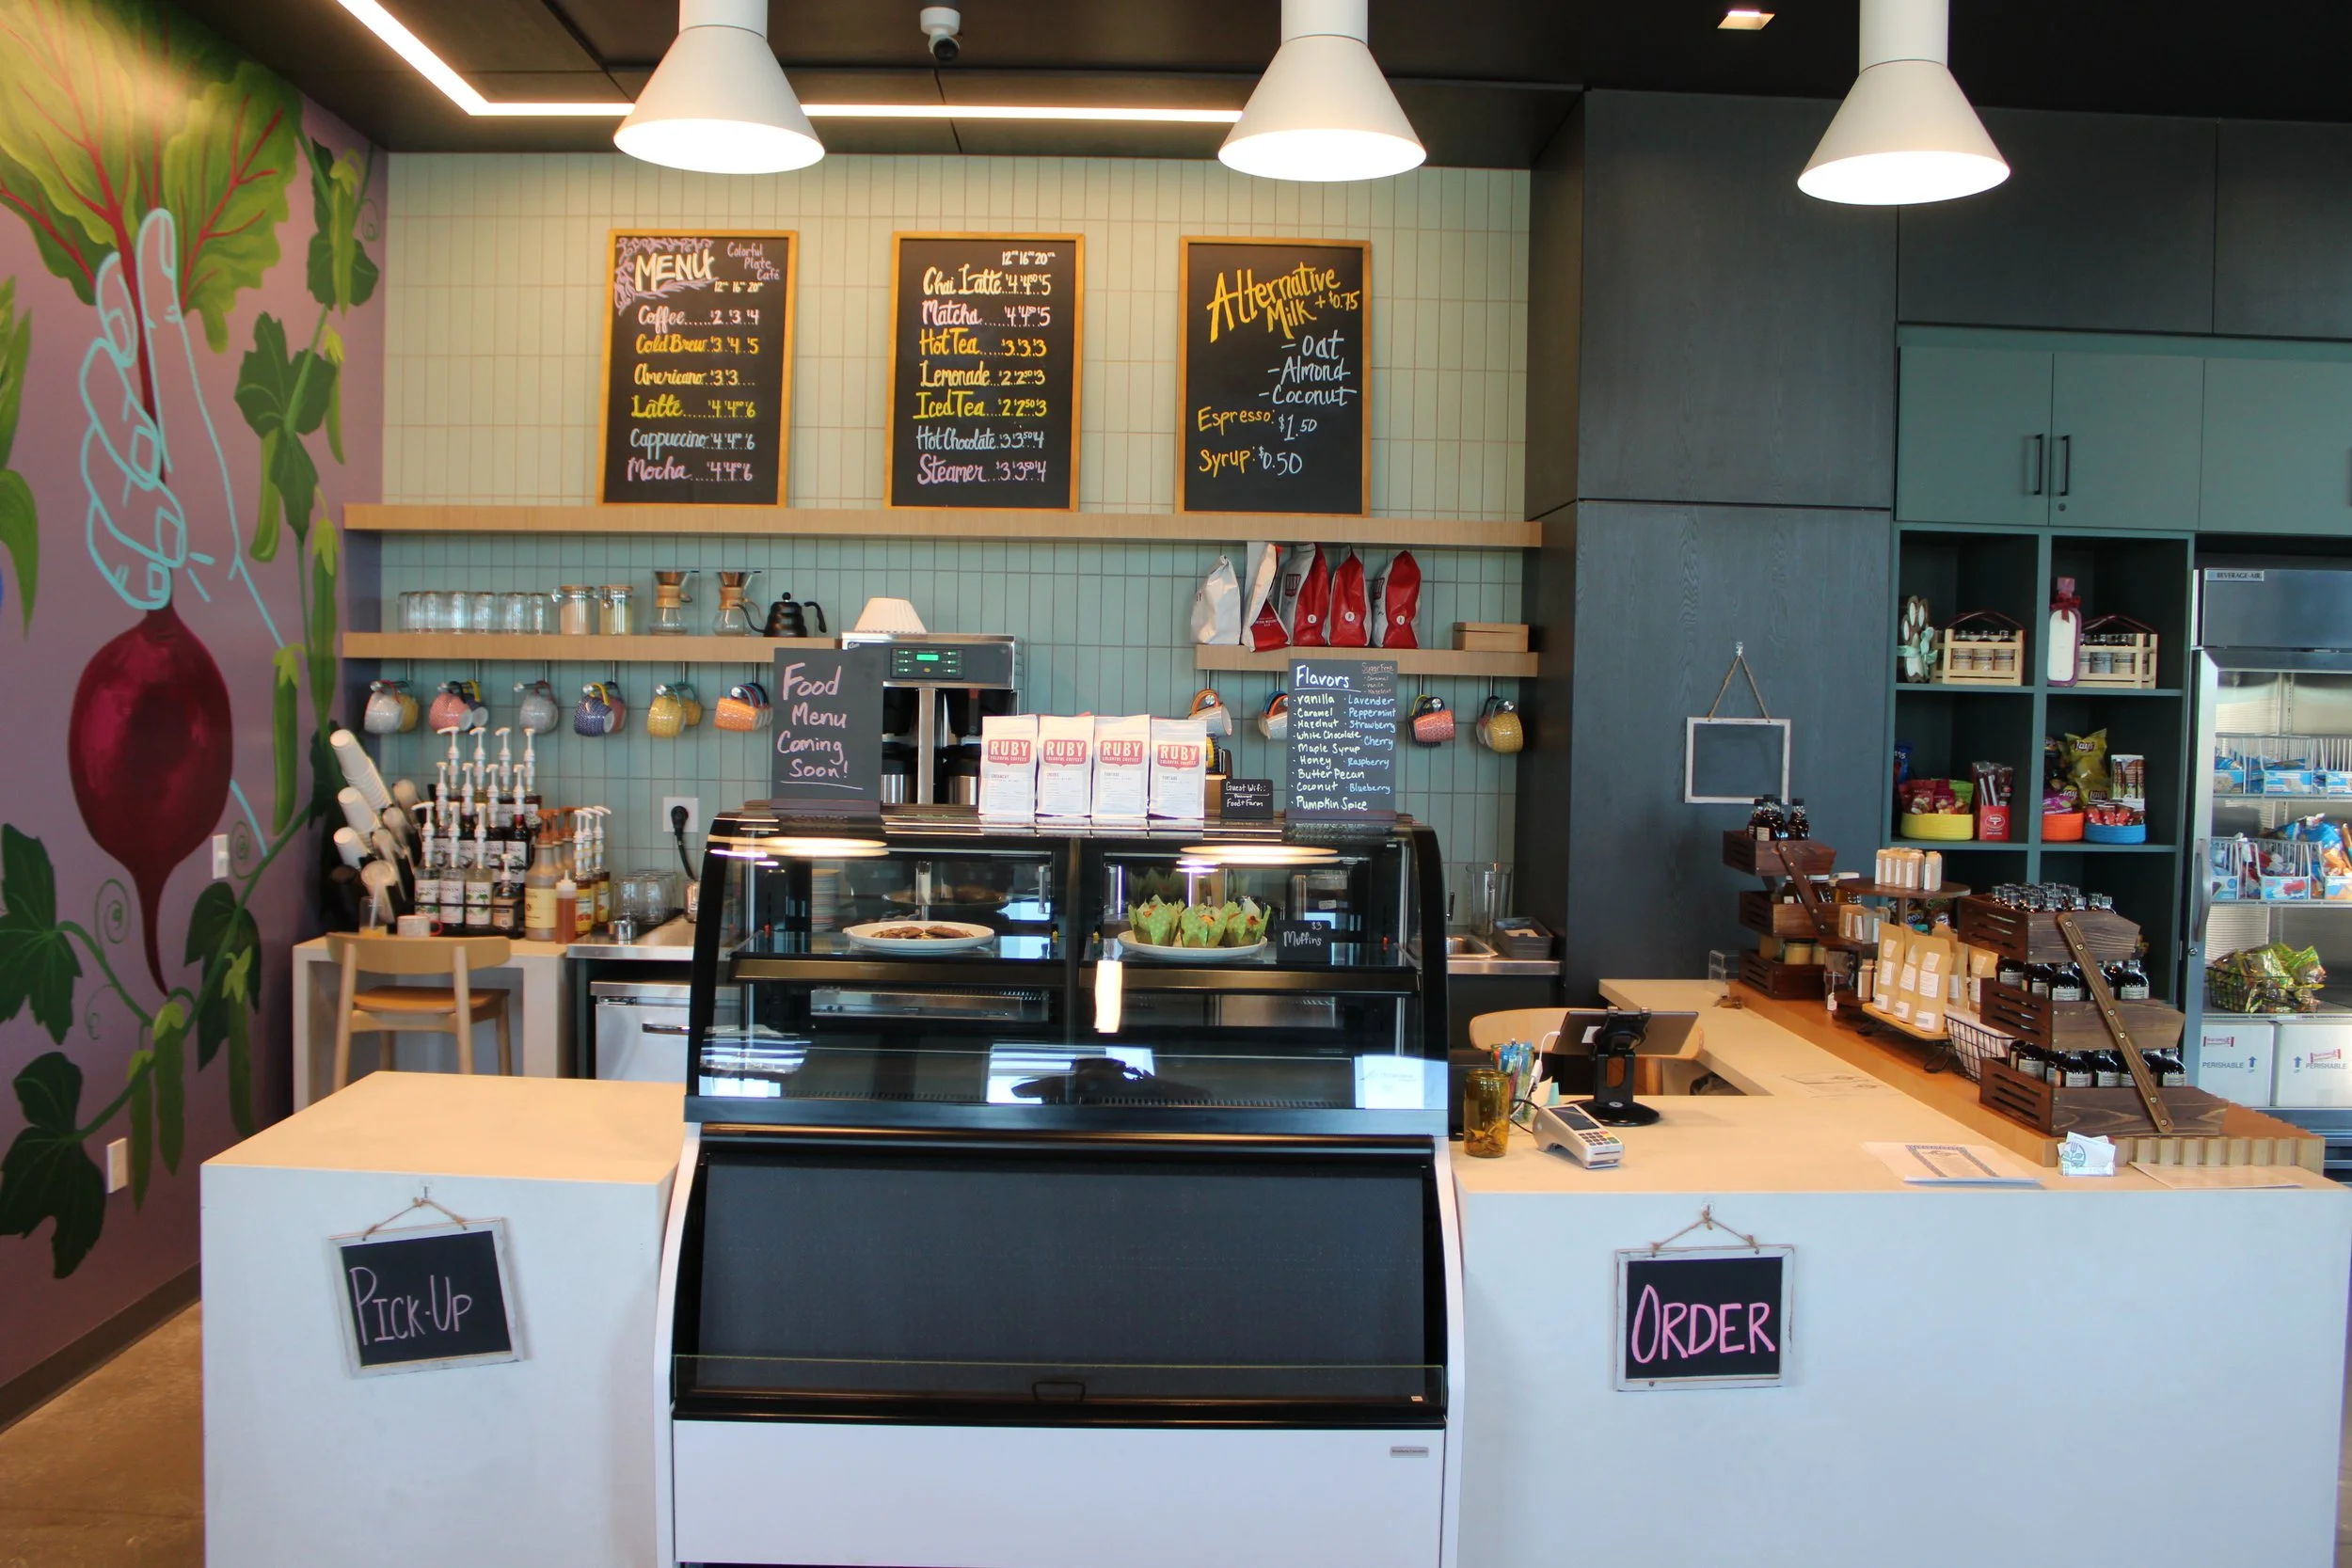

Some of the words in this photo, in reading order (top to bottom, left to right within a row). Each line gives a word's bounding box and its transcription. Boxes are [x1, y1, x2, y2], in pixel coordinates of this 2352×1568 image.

[727, 242, 763, 258] Colorful
[634, 248, 715, 292] MENU
[743, 257, 771, 270] Plate
[923, 266, 957, 295] Chai
[958, 263, 1003, 295] Latte
[922, 299, 983, 326] Matcha
[1206, 261, 1341, 343] Alternative
[638, 305, 686, 334] Coffee
[1266, 298, 1317, 340] Milk
[1328, 291, 1360, 311] $0.75
[636, 333, 669, 355] Cold
[669, 334, 707, 354] Brew
[919, 327, 951, 356] Hot
[949, 327, 980, 356] Tea
[634, 363, 706, 386] Americano
[919, 359, 991, 388] Lemonade
[631, 393, 683, 419] Latte
[913, 388, 954, 420] Iced
[951, 390, 985, 418] Tea
[629, 428, 710, 460] Cappuccino
[916, 425, 946, 451] Hot
[944, 427, 996, 451] Chocolate
[627, 456, 691, 482] Mocha
[916, 453, 987, 485] Steamer
[1258, 445, 1303, 476] $0.50
[783, 662, 842, 701] Food
[1295, 664, 1350, 689] Flavors
[1348, 696, 1394, 705] Lavender
[791, 702, 847, 729] Menu
[1297, 707, 1333, 718] Caramel
[1349, 708, 1396, 720] Peppermint
[1324, 730, 1361, 739] Chocolate
[1349, 721, 1395, 734] Strawberry
[777, 730, 844, 766] Coming
[991, 740, 1029, 756] RUBY
[1046, 741, 1084, 757] RUBY
[1104, 741, 1140, 757] RUBY
[1161, 746, 1197, 761] RUBY
[1298, 743, 1327, 753] Maple
[1332, 743, 1360, 756] Syrup
[1364, 736, 1393, 751] Cherry
[788, 758, 849, 779] Soon!
[1300, 756, 1332, 769] Honey
[1348, 758, 1390, 769] Raspberry
[1298, 768, 1332, 779] Butter
[1334, 769, 1365, 779] Pecan
[1226, 782, 1247, 791] Guest
[1296, 782, 1339, 791] Coconut
[1349, 784, 1391, 794] Blueberry
[1296, 796, 1339, 810] Pumpkin
[1342, 798, 1368, 811] Spice
[1311, 922, 1323, 930] $3
[1283, 930, 1322, 947] Muffins
[1631, 1284, 1775, 1364] ORDER
